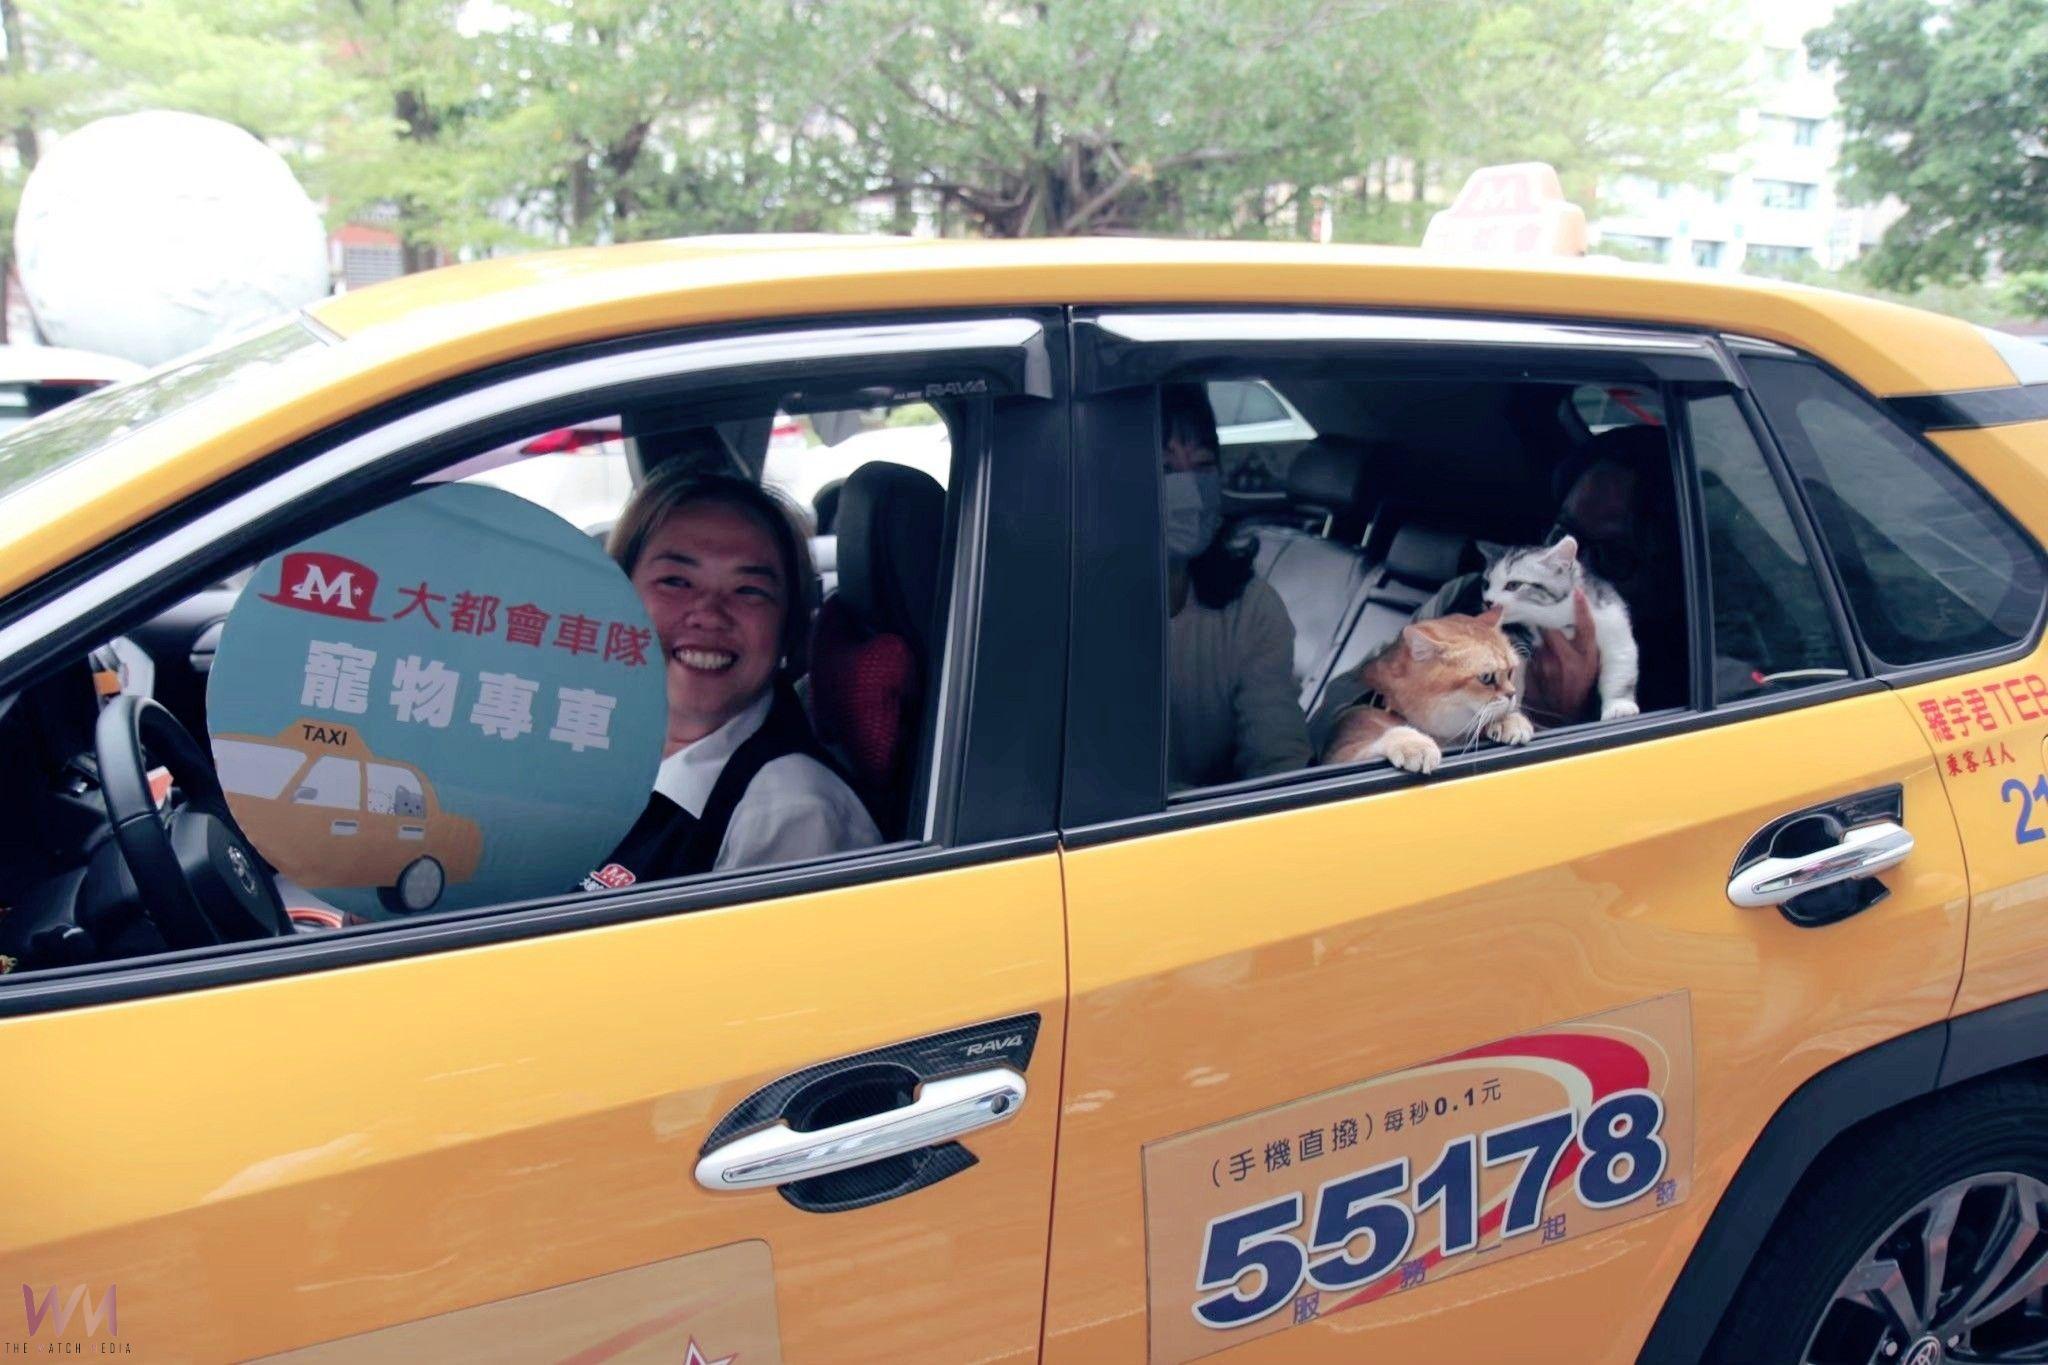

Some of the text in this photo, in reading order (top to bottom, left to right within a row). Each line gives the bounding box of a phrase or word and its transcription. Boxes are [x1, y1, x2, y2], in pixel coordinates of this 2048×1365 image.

[392, 581, 653, 667] 大都會車隊
[300, 639, 618, 752] 寵物專車
[302, 724, 348, 747] TAXI
[2001, 773, 2048, 845] 2
[966, 1033, 1024, 1058] RAV4
[1193, 1087, 1667, 1330] 55178
